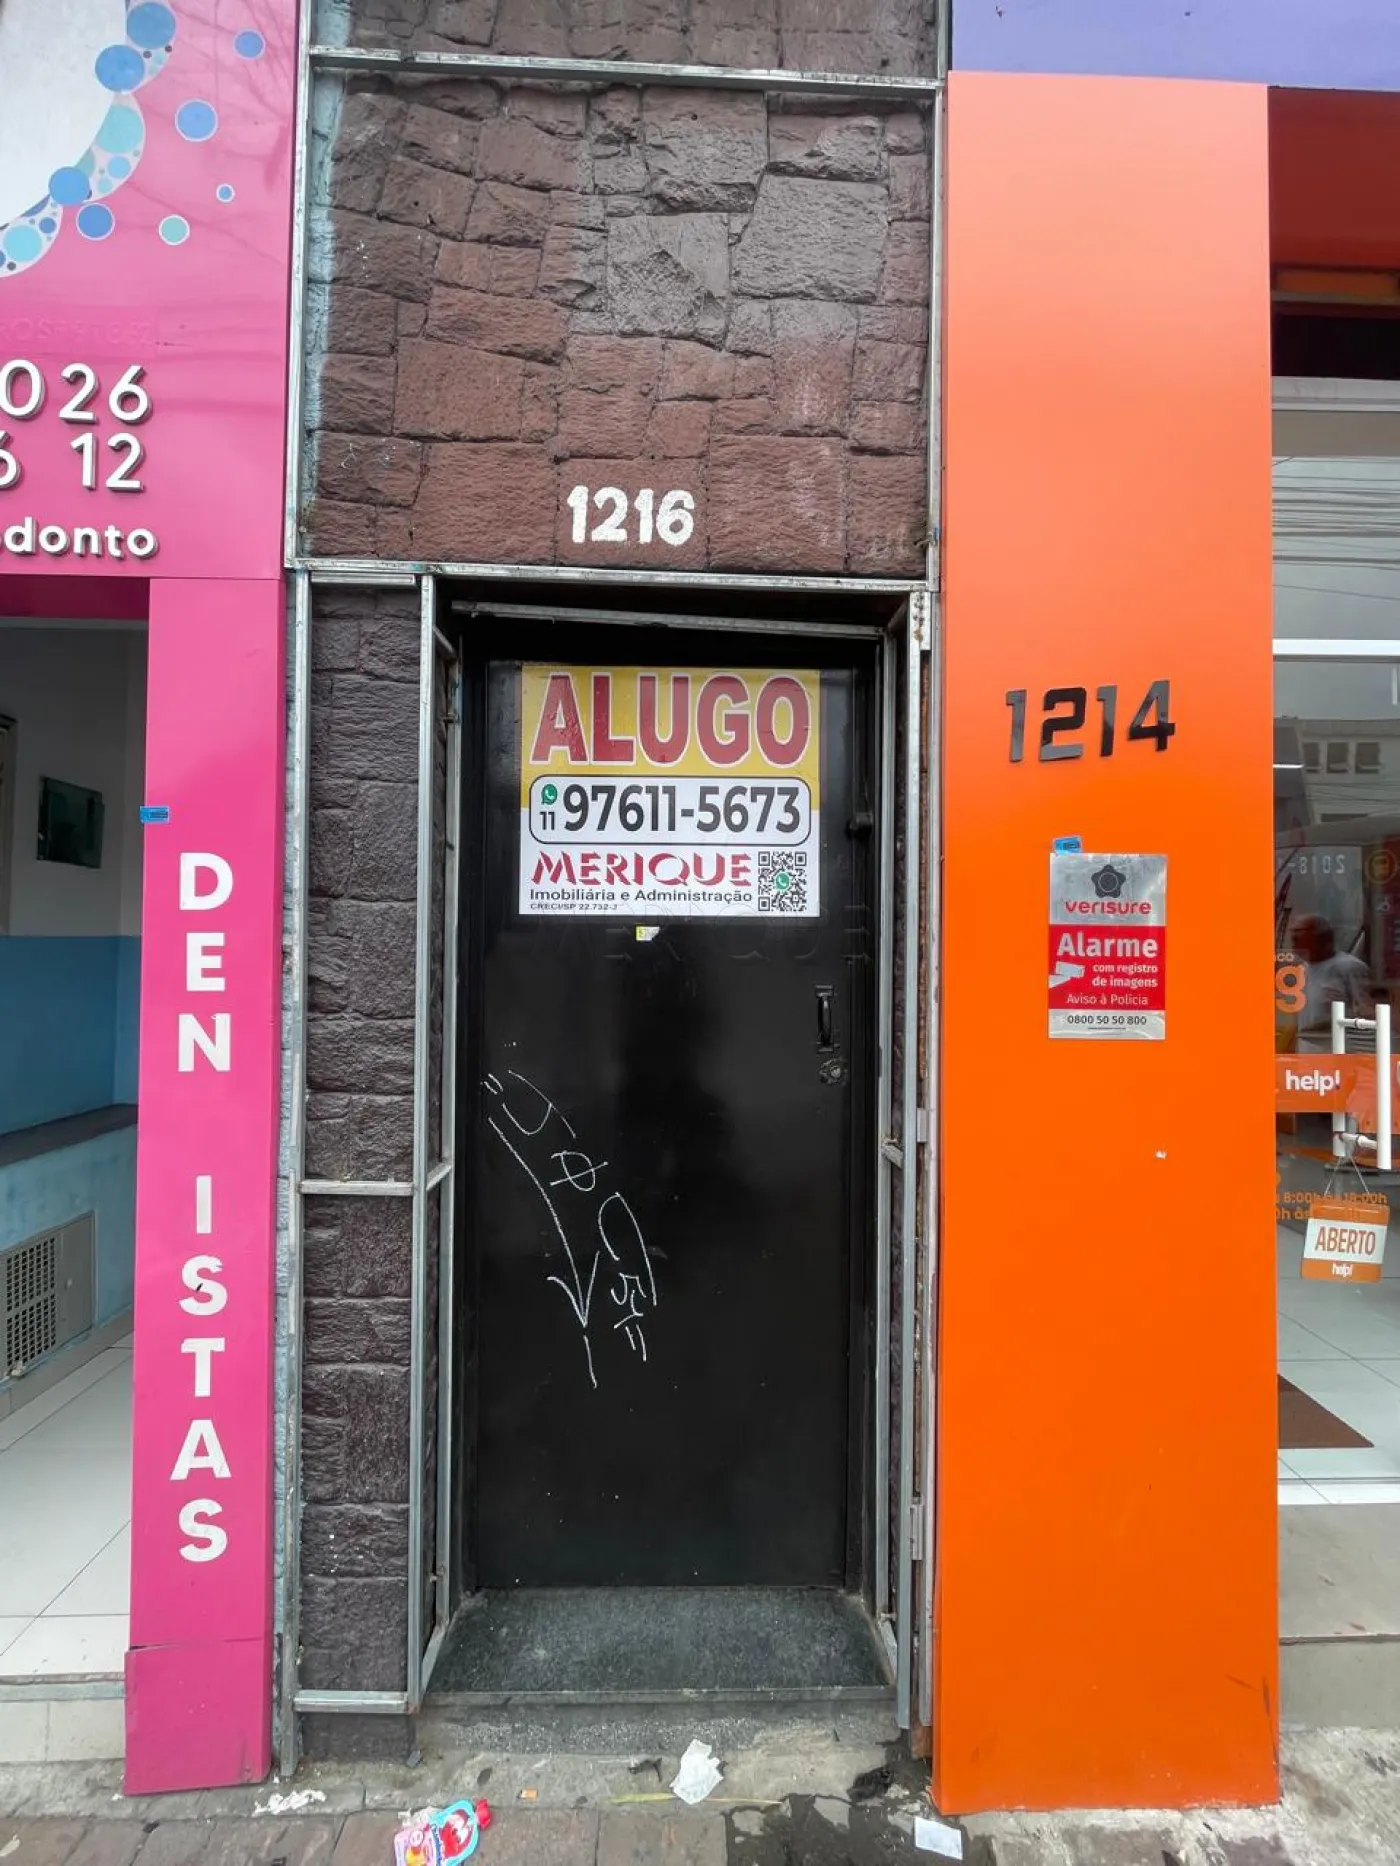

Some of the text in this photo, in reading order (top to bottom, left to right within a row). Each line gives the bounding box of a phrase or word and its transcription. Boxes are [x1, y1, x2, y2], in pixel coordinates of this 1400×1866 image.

[70, 432, 145, 490] 12
[567, 485, 695, 546] 1216
[0, 517, 158, 559] donto
[529, 672, 811, 767] ALUGO
[1006, 680, 1176, 762] 1214
[540, 783, 801, 833] 11 97611-5673
[530, 850, 752, 887] MERIQUE
[530, 888, 752, 904] Imobiliária e Administração
[1064, 900, 1152, 915] verisure
[1056, 931, 1159, 958] Alarme
[1092, 961, 1159, 975] com registro
[1092, 975, 1159, 989] de imagens
[1066, 993, 1097, 1005] Aviso
[1067, 1014, 1147, 1025] 0800 50 50 800
[1285, 1069, 1341, 1096] help!
[1314, 1225, 1377, 1256] ABERTO
